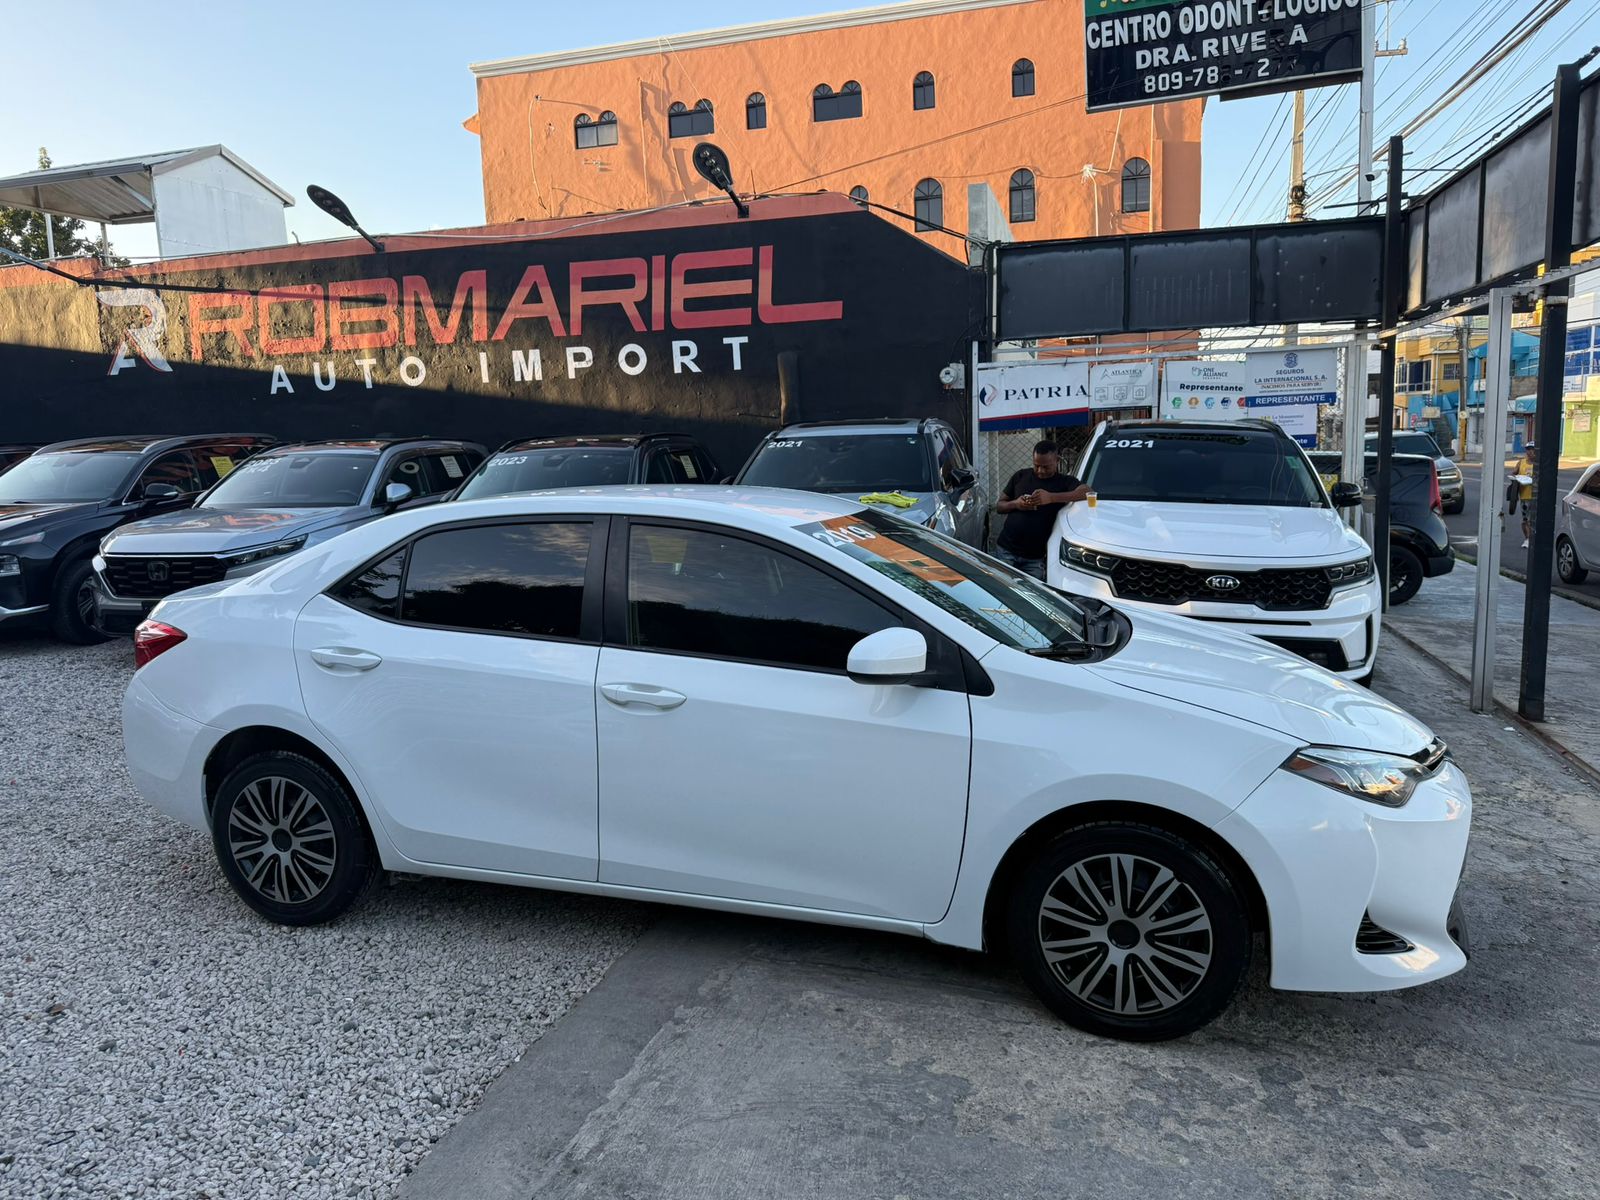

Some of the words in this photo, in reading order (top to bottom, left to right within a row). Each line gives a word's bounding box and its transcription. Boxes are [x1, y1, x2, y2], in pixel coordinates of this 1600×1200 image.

[1086, 10, 1172, 50] CENTRO
[1135, 42, 1198, 70] DRA.
[1202, 23, 1309, 60] RIVEA
[189, 244, 844, 361] ROBMARIEL
[270, 355, 428, 396] AUTO
[479, 336, 749, 384] IMPORT
[1263, 375, 1313, 383] INTERNACIONAL
[1004, 384, 1089, 401] PATRIA
[1179, 383, 1244, 392] Representante
[1255, 394, 1326, 404] REPRESENTANTE
[767, 440, 803, 449] 2021
[1104, 439, 1154, 449] 2021
[487, 456, 528, 467] 2023
[811, 525, 876, 548] 2019
[1211, 578, 1234, 588] KIA
